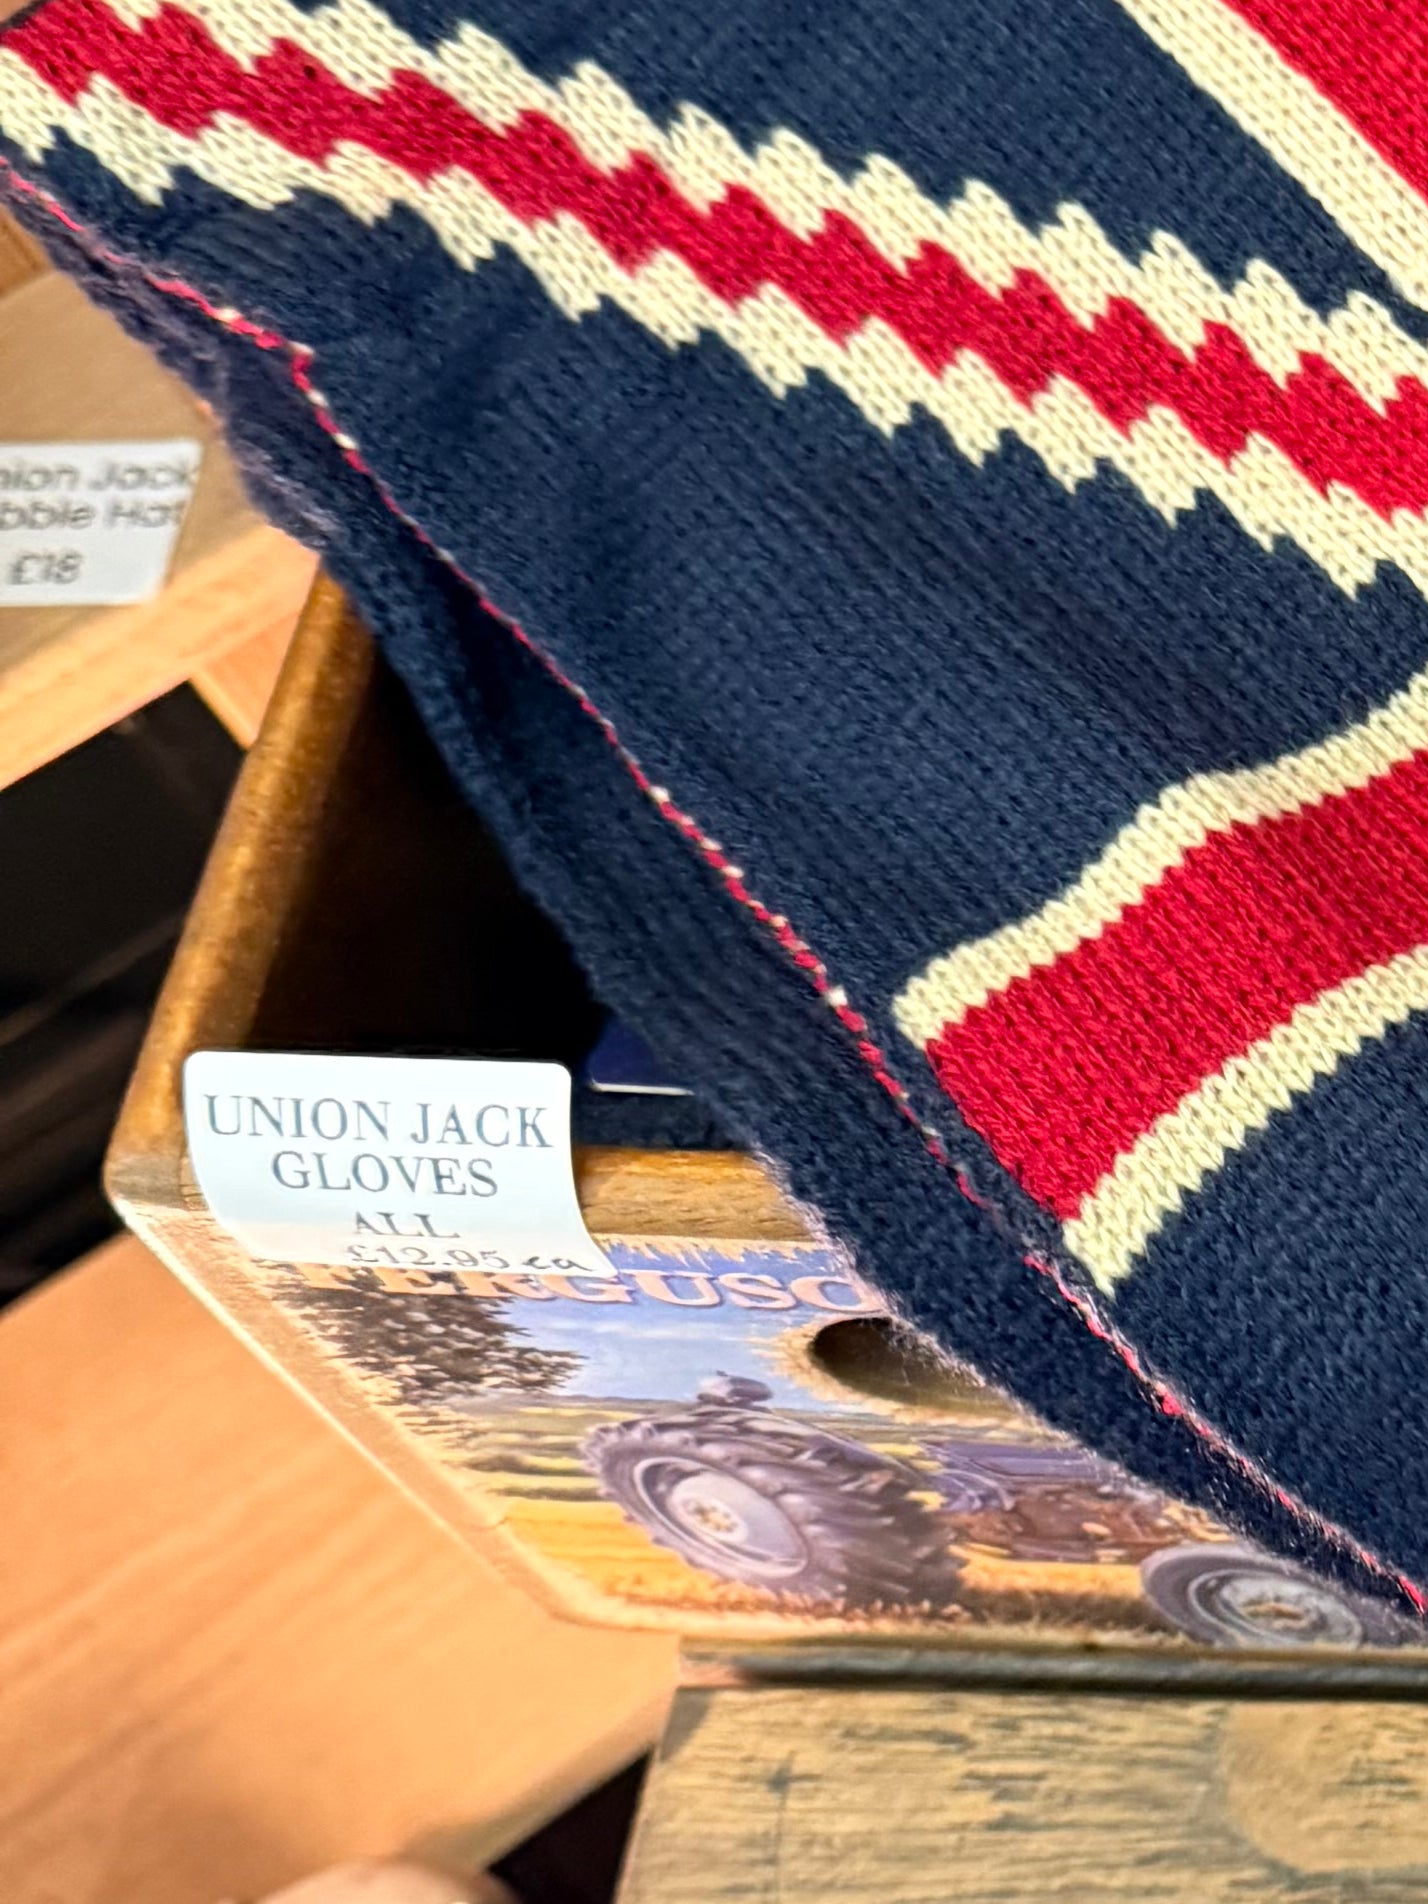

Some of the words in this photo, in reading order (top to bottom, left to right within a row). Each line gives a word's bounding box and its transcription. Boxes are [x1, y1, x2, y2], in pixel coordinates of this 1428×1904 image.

[10, 548, 83, 585] £18
[203, 1094, 391, 1142] UNION
[410, 1102, 555, 1149] JACK
[270, 1149, 499, 1198] GLOVES
[353, 1210, 461, 1239] ALL
[346, 1244, 510, 1270] £12.95
